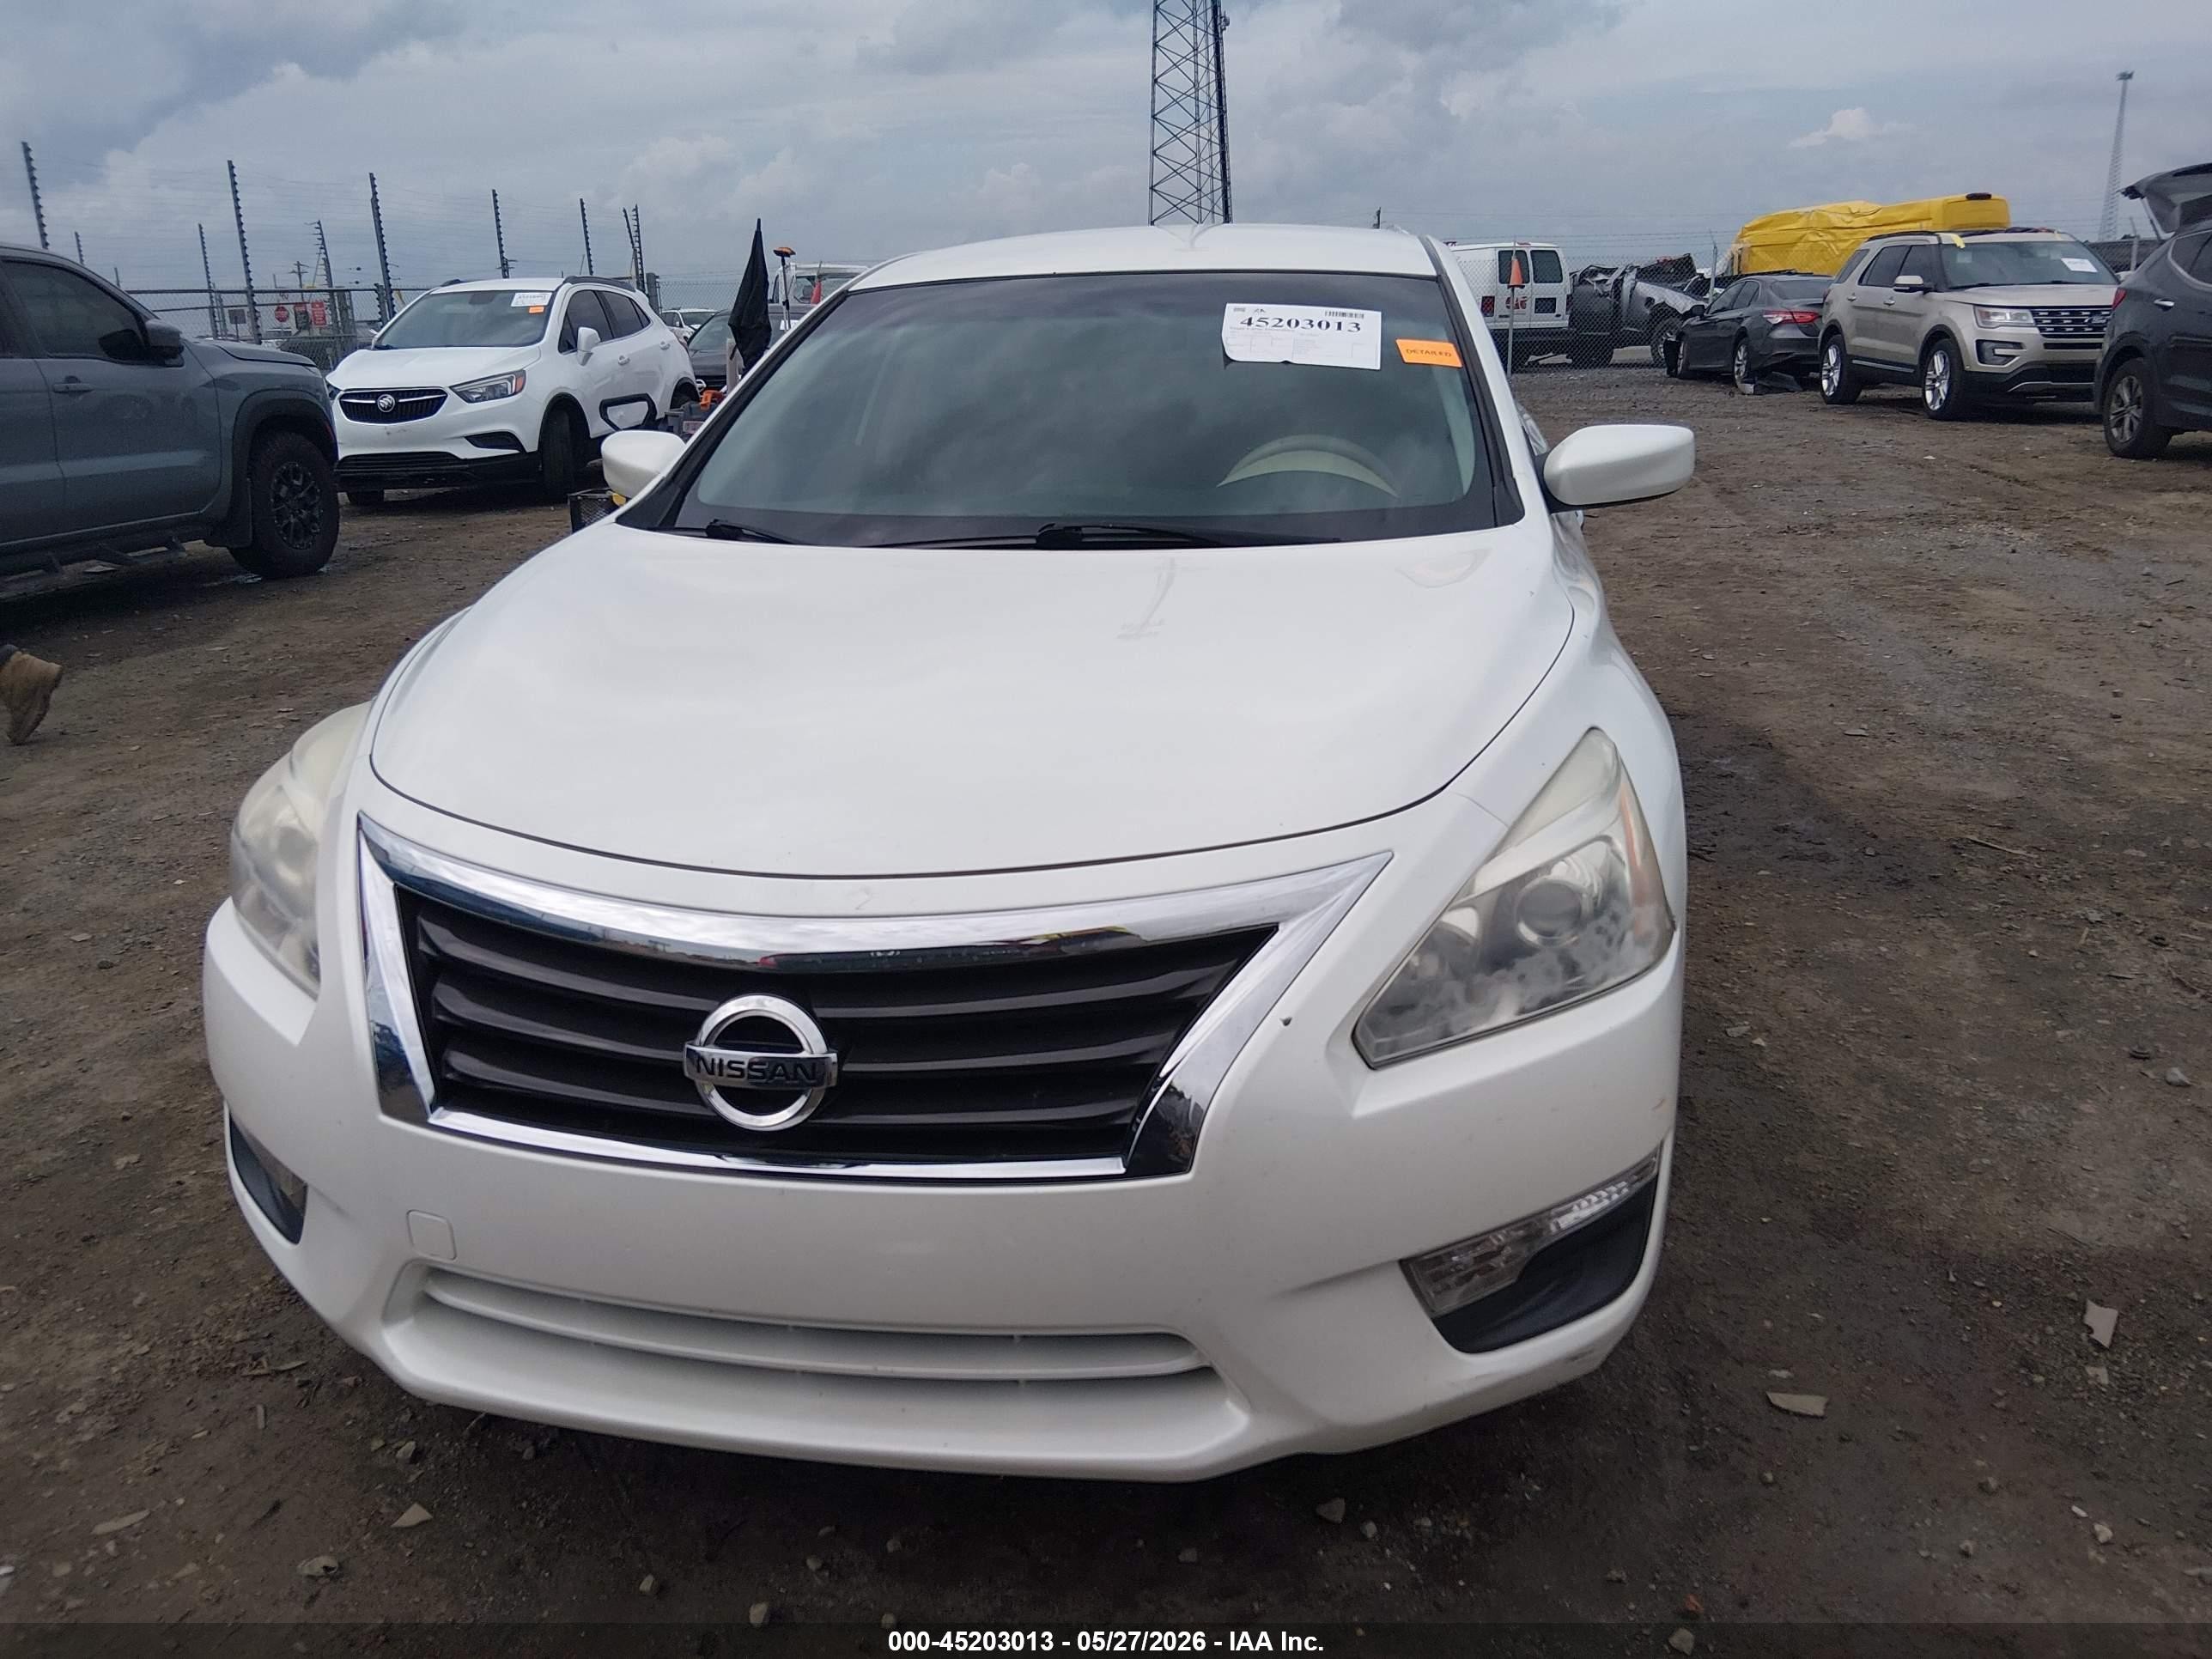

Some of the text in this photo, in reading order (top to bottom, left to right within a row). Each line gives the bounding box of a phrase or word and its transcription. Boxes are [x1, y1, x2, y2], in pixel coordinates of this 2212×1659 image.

[1239, 316, 1361, 333] 45203013
[1406, 349, 1452, 357] DETAILED
[696, 1056, 817, 1084] NISSAN
